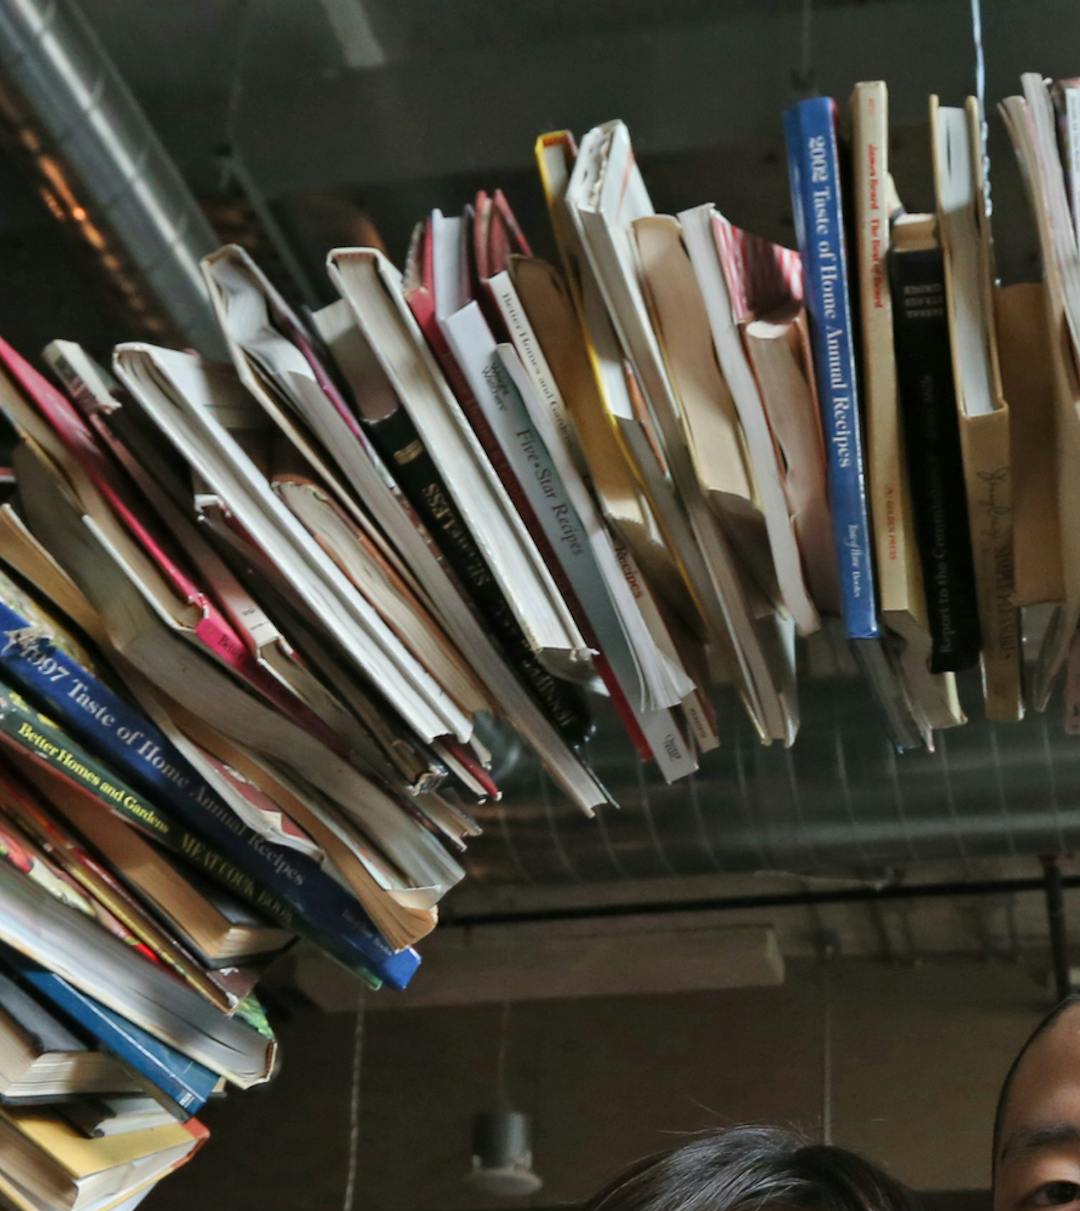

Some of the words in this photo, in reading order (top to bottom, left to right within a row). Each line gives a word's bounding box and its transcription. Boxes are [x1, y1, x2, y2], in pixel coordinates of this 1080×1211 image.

[808, 135, 828, 182] 2002
[813, 186, 831, 235] Taste
[870, 219, 880, 239] The
[818, 241, 837, 260] of
[820, 264, 838, 320] Home
[500, 292, 522, 330] Better
[518, 330, 541, 376] Homes
[538, 376, 552, 397] and
[826, 325, 848, 390] Annual
[832, 396, 852, 469] Recipes
[551, 503, 584, 556] Recipes
[18, 722, 58, 756] Better
[55, 748, 102, 787] Homes
[99, 779, 126, 801] and
[122, 796, 171, 834] Gardens
[67, 678, 116, 728] Taste
[116, 726, 144, 745] of
[137, 740, 191, 789] Home
[191, 785, 248, 836] Annual
[249, 833, 306, 887] Recipes
